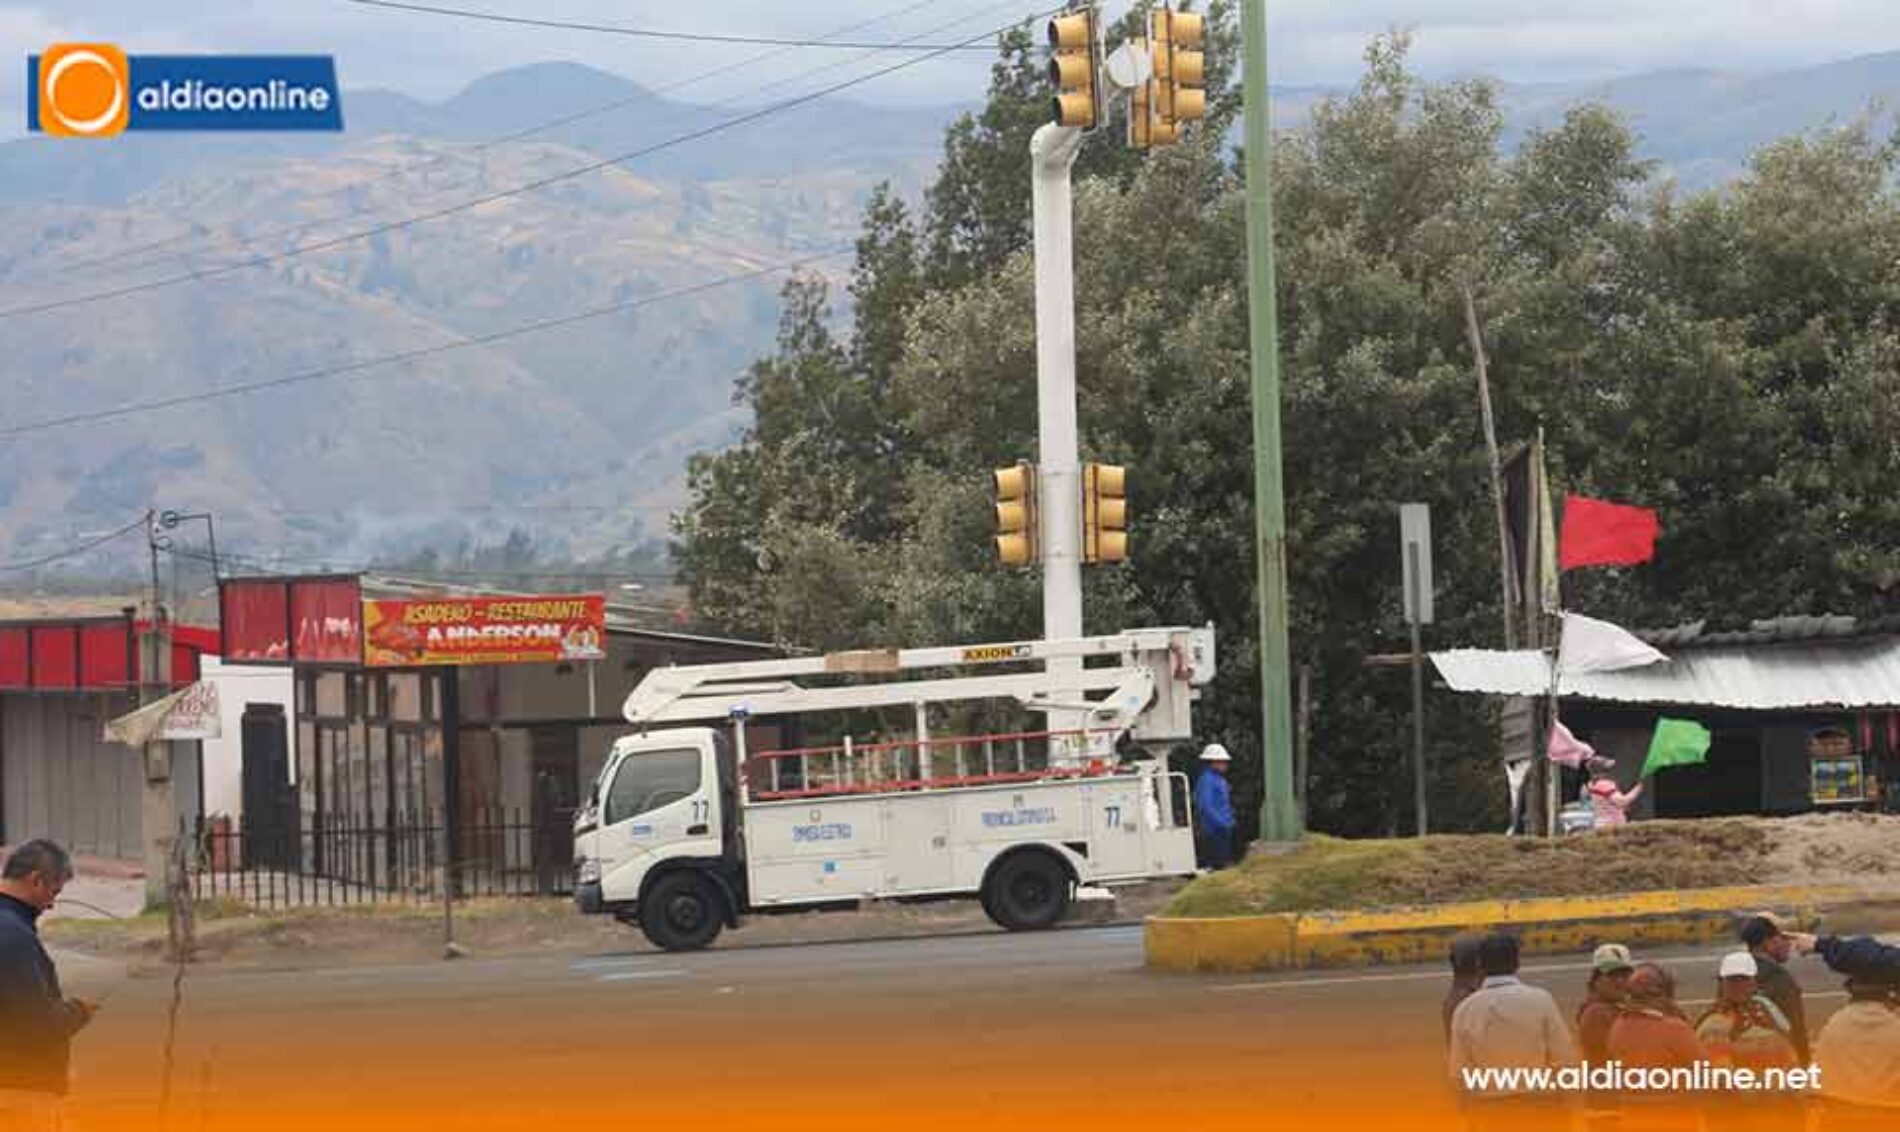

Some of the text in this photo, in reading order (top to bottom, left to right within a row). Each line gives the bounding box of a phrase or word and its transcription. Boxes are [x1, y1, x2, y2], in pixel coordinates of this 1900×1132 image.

[487, 601, 585, 621] RESTAURANTE
[427, 623, 562, 649] ANDERSON
[964, 646, 1013, 660] AXION
[692, 800, 709, 823] 77
[1104, 806, 1121, 829] 77
